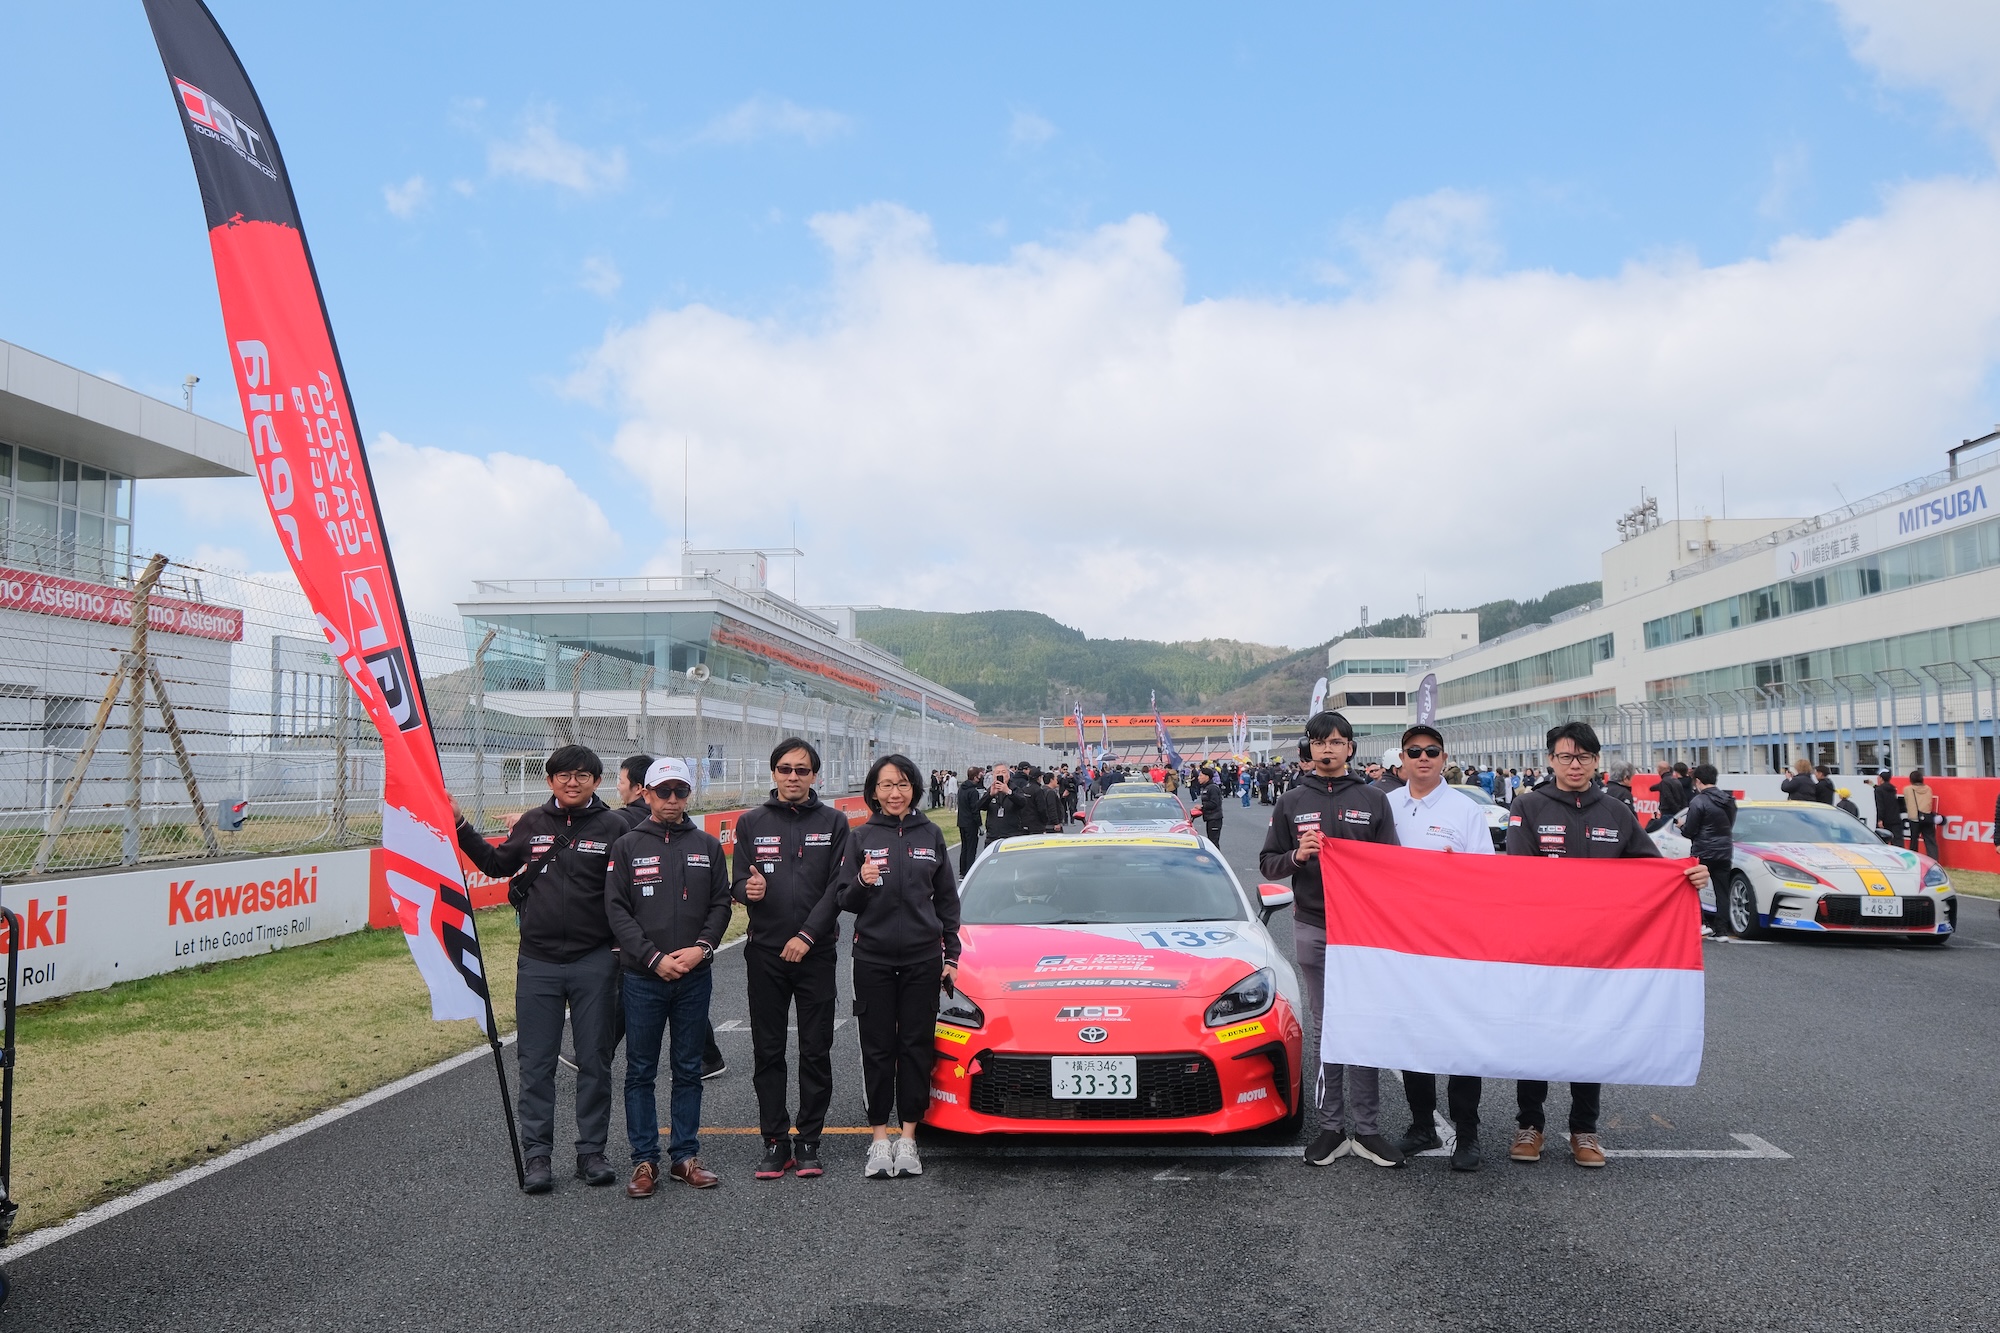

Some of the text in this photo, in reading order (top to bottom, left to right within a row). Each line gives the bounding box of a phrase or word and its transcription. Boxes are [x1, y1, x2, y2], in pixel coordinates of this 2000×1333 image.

[1899, 485, 1988, 536] MITSUBA
[1802, 533, 1860, 568] 川崎設備工業
[30, 580, 106, 614] Astemo
[110, 595, 175, 625] Asmo
[180, 607, 236, 634] Astemo
[168, 865, 318, 926] Kawasaki
[1871, 904, 1900, 915] 48-21
[174, 916, 312, 957] Let the Good Times Roll
[1140, 930, 1239, 948] 139
[1034, 963, 1155, 973] Indonesia
[1038, 956, 1088, 966] GR
[22, 962, 56, 987] Roll
[1063, 1006, 1123, 1018] TCD
[935, 1028, 967, 1040] DUNLOP
[1227, 1025, 1260, 1038] DUNLOP
[1072, 1060, 1118, 1072] 横浜346
[1057, 1074, 1132, 1096] ふ 33-33
[1236, 1087, 1268, 1104] MOTUL
